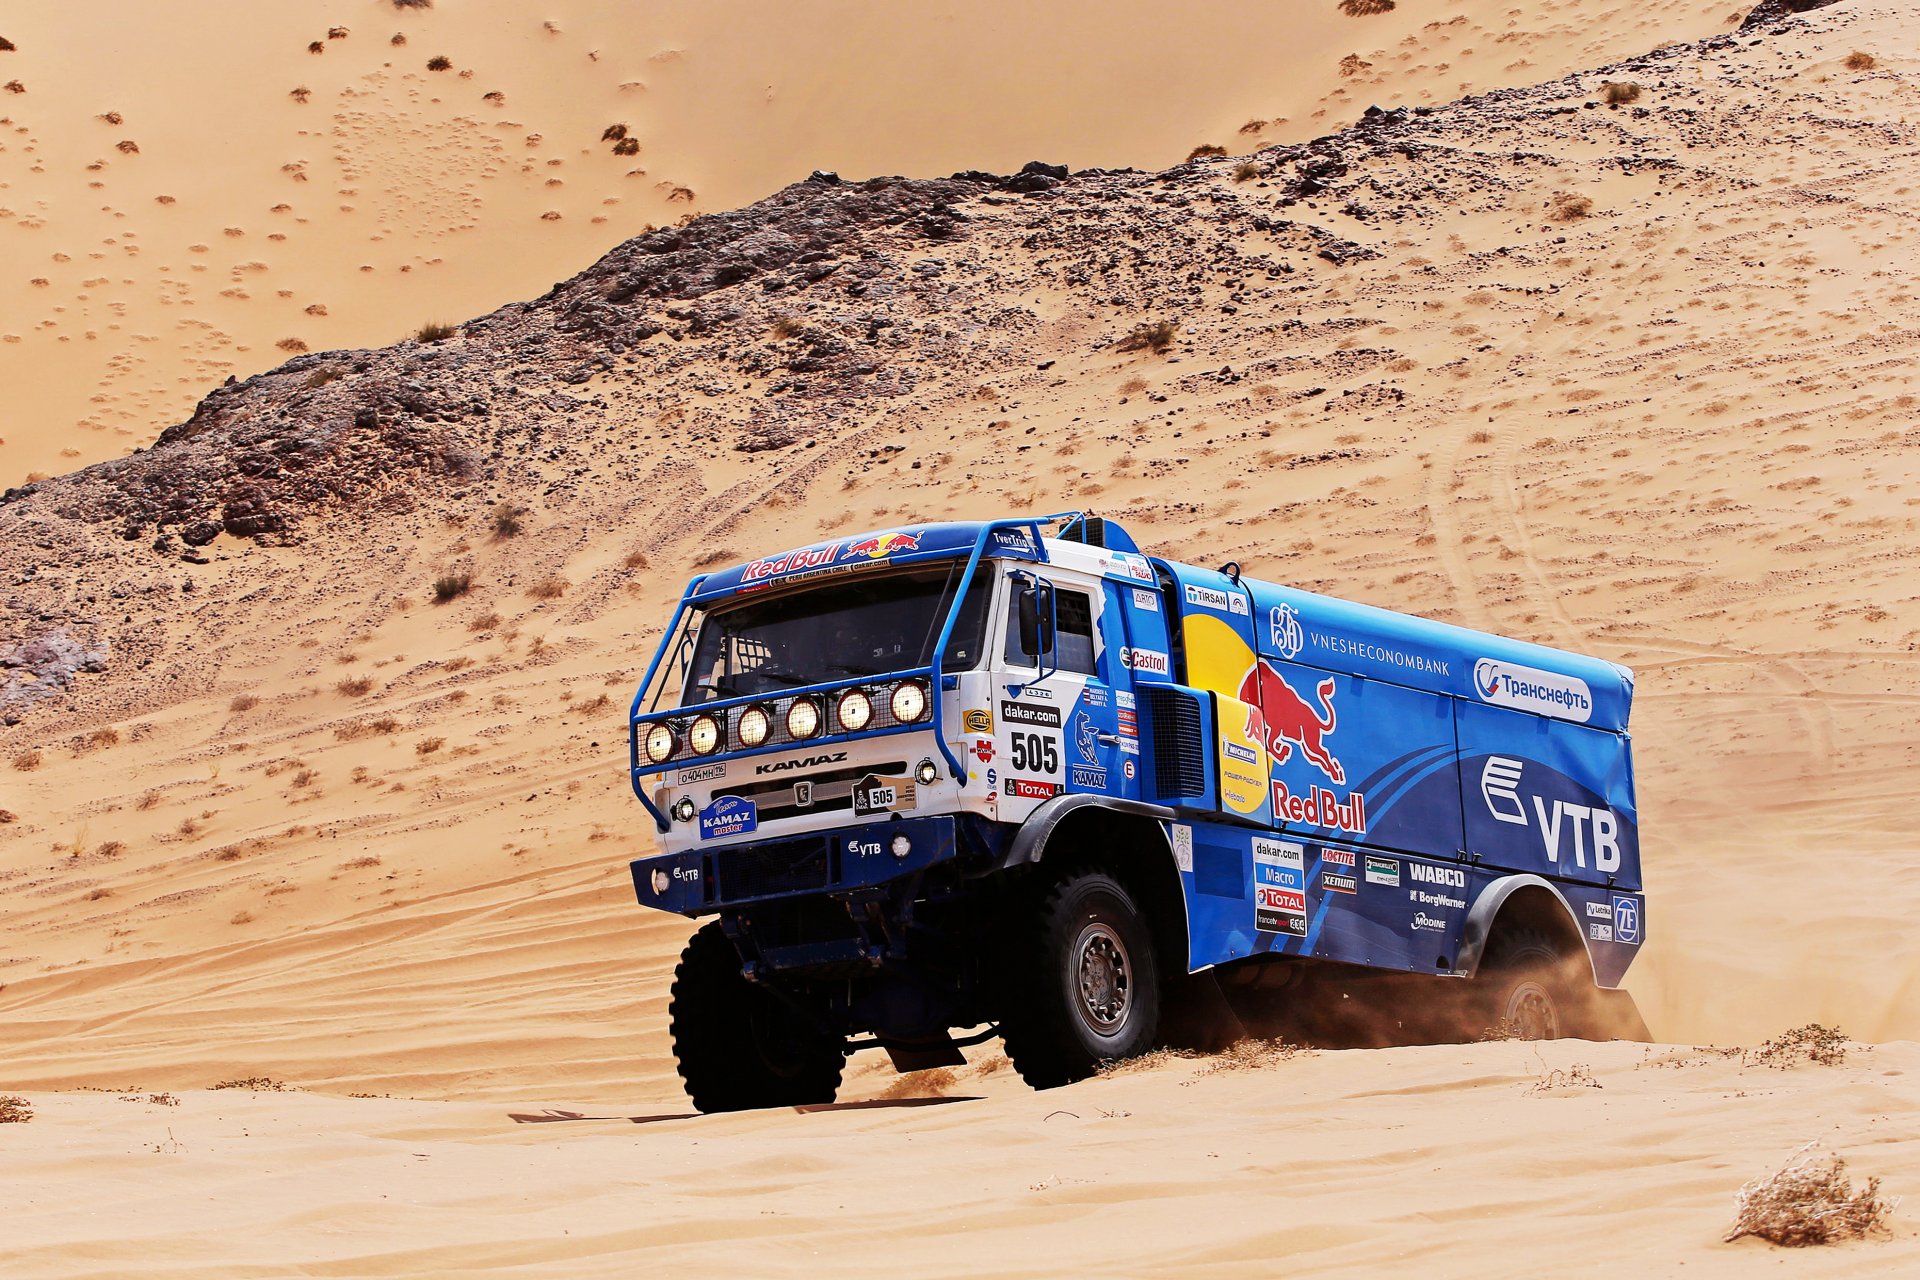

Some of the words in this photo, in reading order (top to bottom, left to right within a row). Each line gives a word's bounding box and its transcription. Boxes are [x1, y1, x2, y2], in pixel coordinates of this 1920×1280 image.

[993, 532, 1028, 548] TverTrip
[854, 560, 888, 570] dakar.com
[1132, 651, 1166, 672] Castrol
[1310, 631, 1450, 677] VNESHECONOMBANK
[1501, 673, 1589, 711] Транснефть
[969, 717, 990, 725] HELLA
[1004, 704, 1058, 724] dakar.com
[1010, 731, 1058, 775] 505
[1230, 746, 1255, 760] MICHELIN
[755, 752, 848, 775] KAMAZ
[1126, 763, 1132, 776] E
[1072, 770, 1107, 789] KAMAZ
[872, 789, 893, 805] 505
[1017, 782, 1053, 797] TOTAL
[713, 800, 738, 814] Team
[703, 811, 751, 828] KAMAZ
[1532, 795, 1621, 874] VTB
[859, 843, 882, 857] VTB
[1256, 842, 1300, 861] dakar.com
[1322, 849, 1354, 865] LOCTITE
[1265, 867, 1295, 885] Macro
[1408, 862, 1465, 888] WABCO
[1268, 891, 1304, 909] TOTAL
[1419, 891, 1466, 909] BorgWarner
[1414, 916, 1447, 929] MODINE
[1617, 907, 1636, 933] ZF
